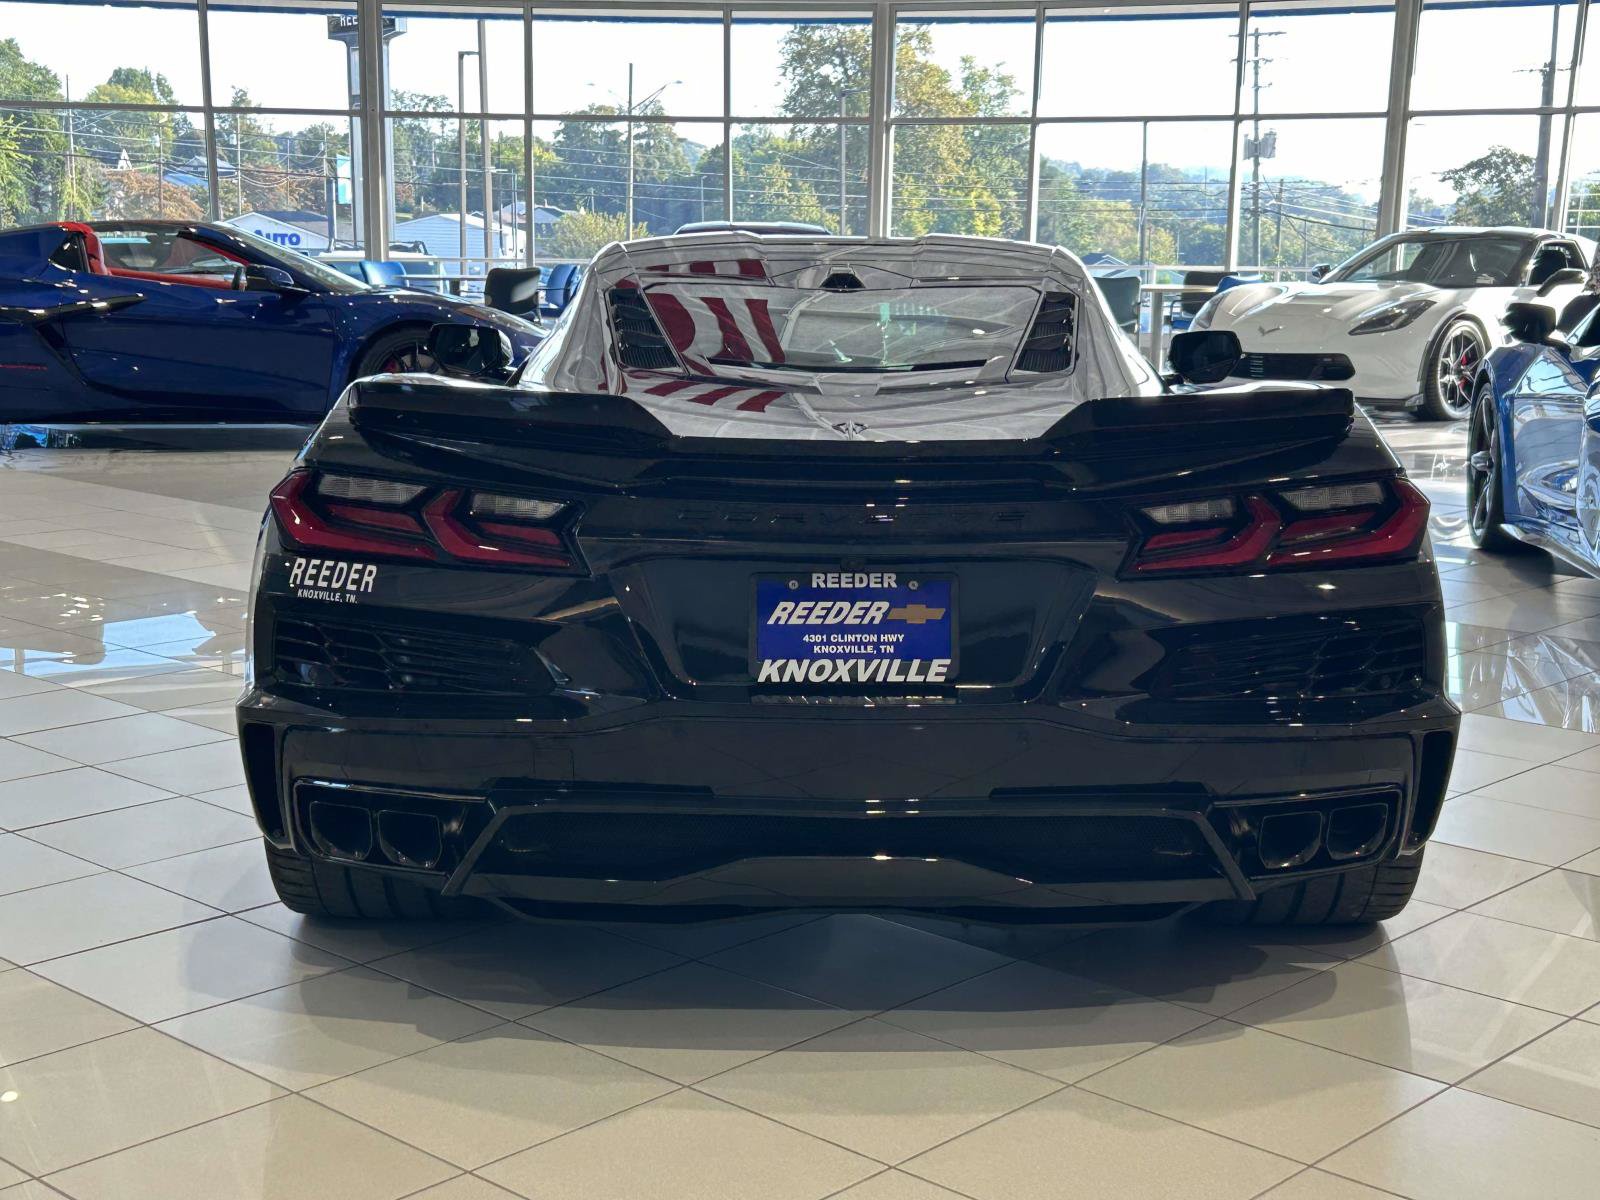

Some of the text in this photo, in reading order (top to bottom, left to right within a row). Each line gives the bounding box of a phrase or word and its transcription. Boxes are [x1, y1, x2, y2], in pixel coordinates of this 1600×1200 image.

[289, 557, 377, 593] REEDER
[811, 573, 898, 589] REEDER
[297, 588, 358, 604] KNOXVILLE, TN.
[766, 601, 890, 625] REEDER
[802, 634, 905, 643] 4301 CLINTON HWY
[813, 645, 895, 655] KNOXVILLE, TN
[757, 658, 952, 684] KNOXVILLE
